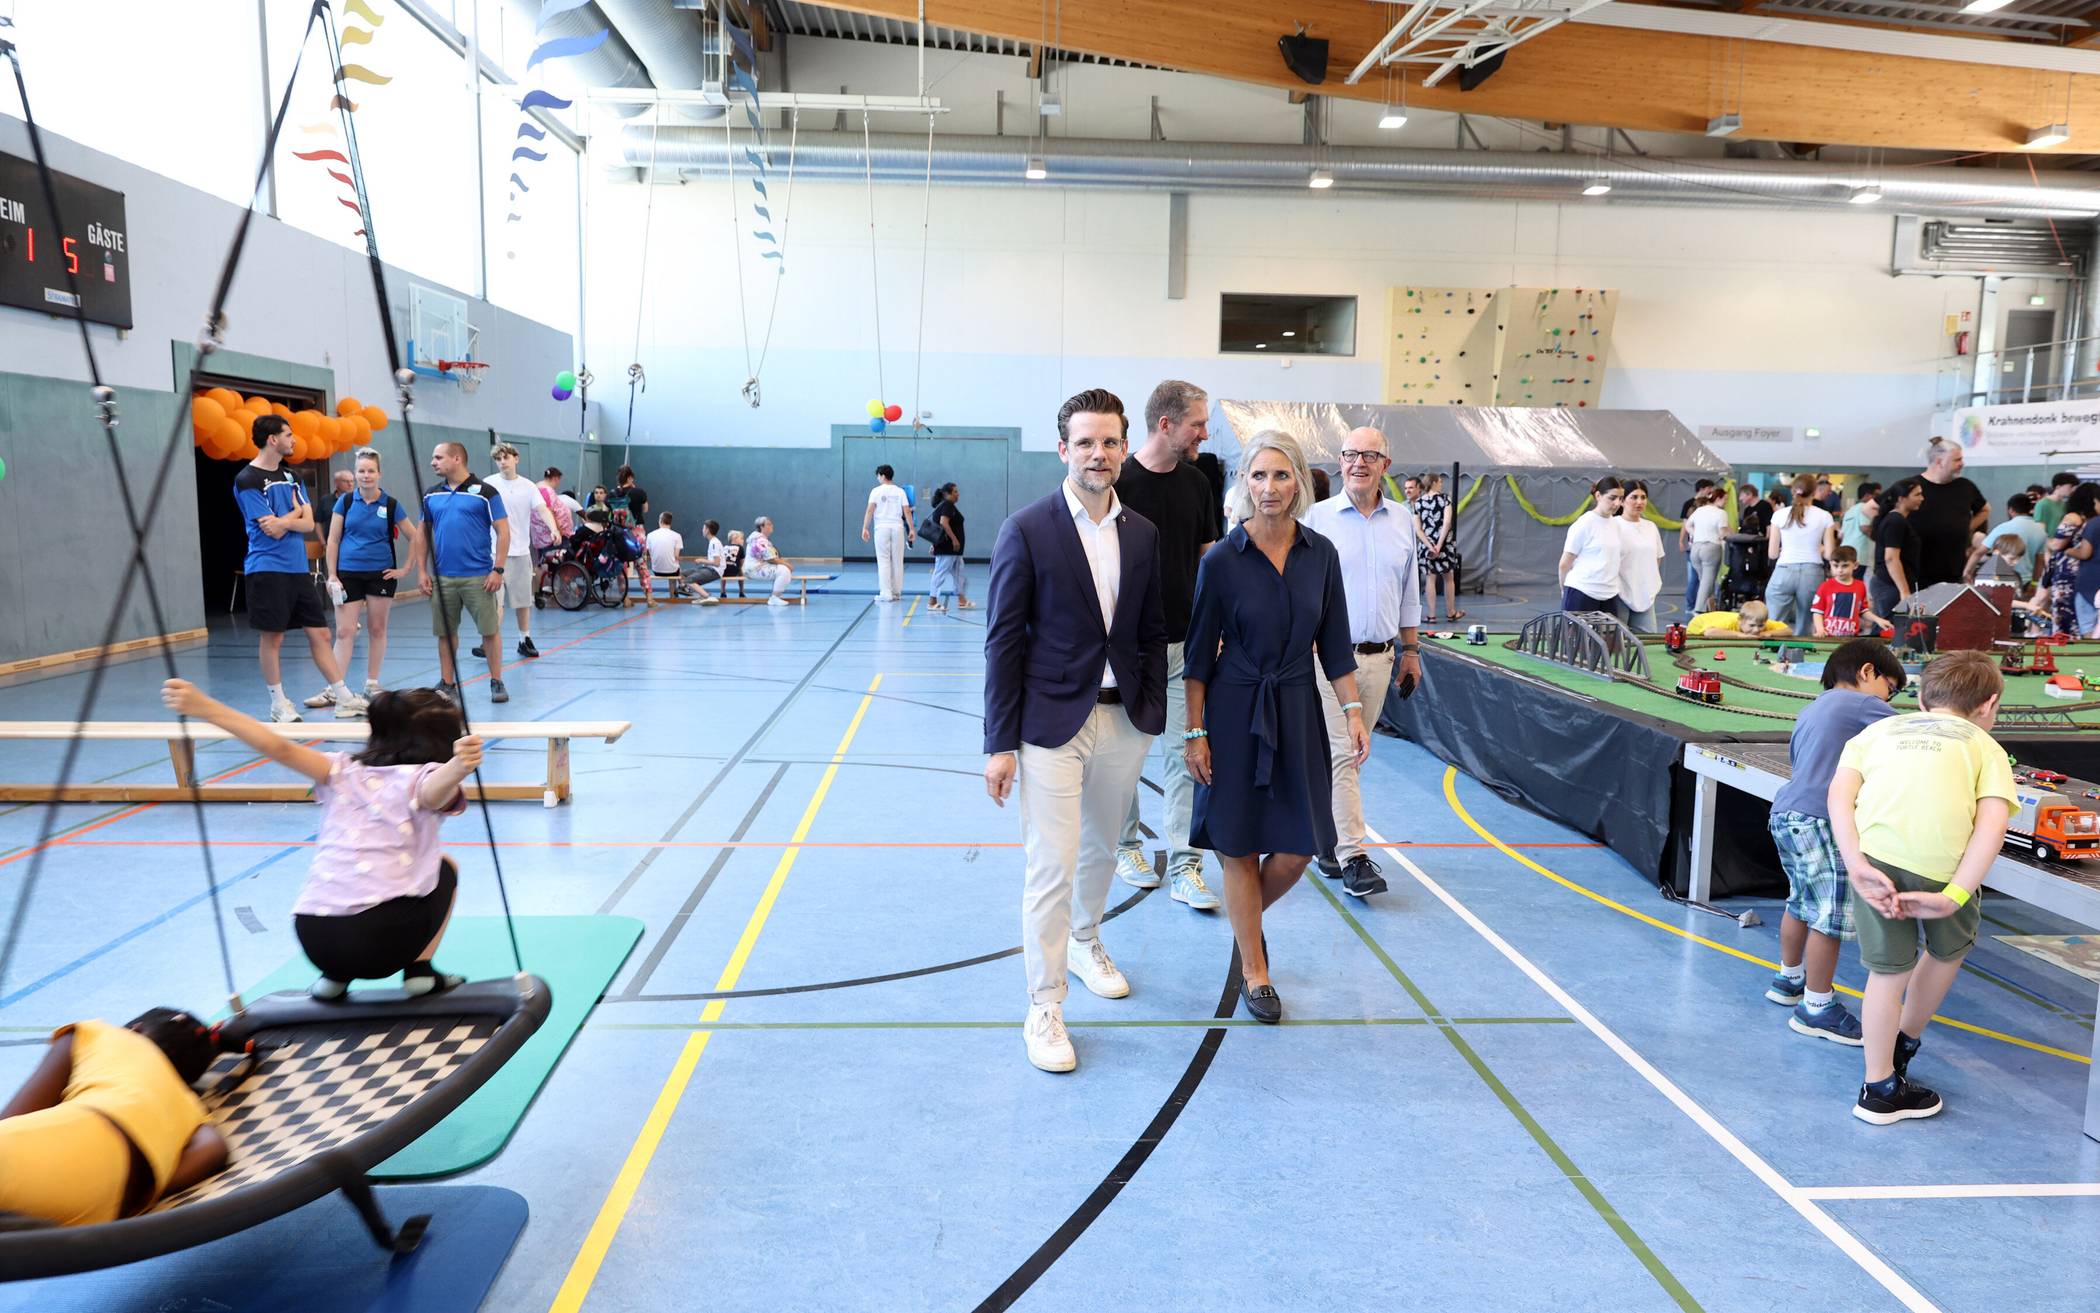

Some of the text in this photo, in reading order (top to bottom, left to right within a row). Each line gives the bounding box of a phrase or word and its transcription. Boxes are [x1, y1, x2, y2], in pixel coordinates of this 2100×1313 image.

[87, 222, 125, 253] GÄSTE
[63, 237, 79, 274] 5
[1988, 413, 2057, 426] Krahnendonk
[1712, 427, 1781, 439] Ausgang Foyer
[1824, 618, 1857, 633] QATAR
